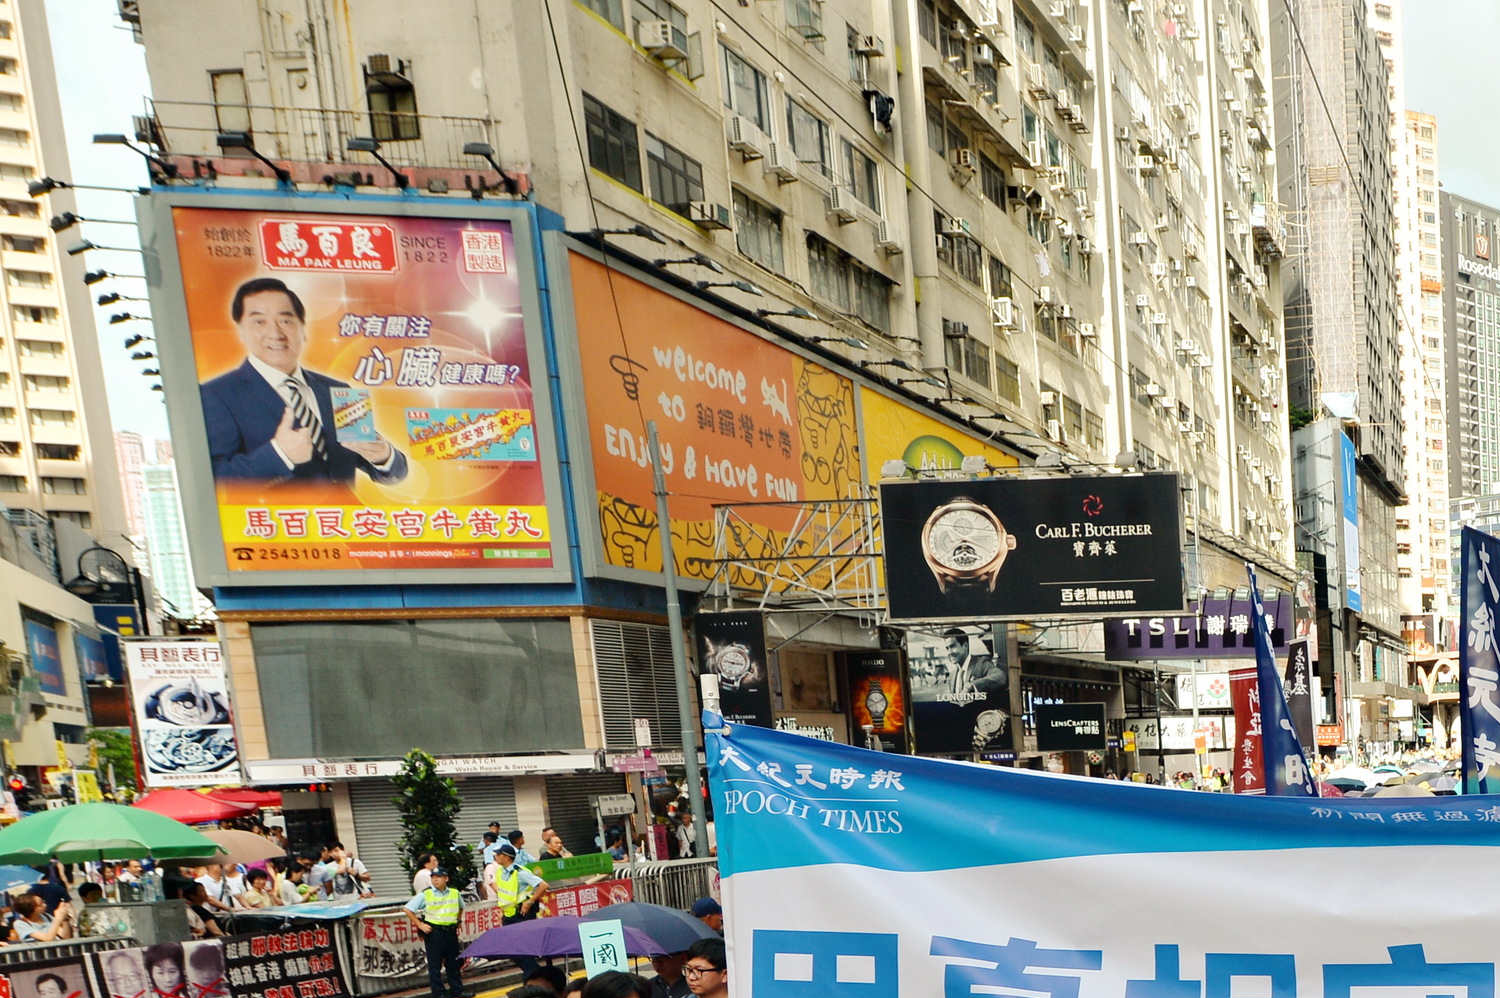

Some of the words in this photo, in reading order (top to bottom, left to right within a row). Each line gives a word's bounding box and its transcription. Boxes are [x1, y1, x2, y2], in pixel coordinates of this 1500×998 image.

[400, 235, 447, 249] SINCE
[464, 232, 500, 251] 香港
[278, 256, 300, 267] MA
[303, 257, 334, 268] PAK
[336, 258, 383, 270] LEUNG
[466, 253, 505, 272] 製造
[338, 314, 431, 338] 你有關注
[652, 344, 747, 405] welcome
[657, 391, 686, 422] to
[684, 445, 697, 480] &
[1035, 523, 1070, 539] CARL
[1084, 522, 1153, 538] BUCHERER
[259, 547, 342, 560] 25431018
[936, 692, 988, 702] LONGINES
[461, 758, 497, 766] WATCH
[478, 765, 502, 773] Repair
[512, 764, 539, 772] Service
[724, 789, 812, 820] EPOCH
[816, 807, 904, 835] TIMES
